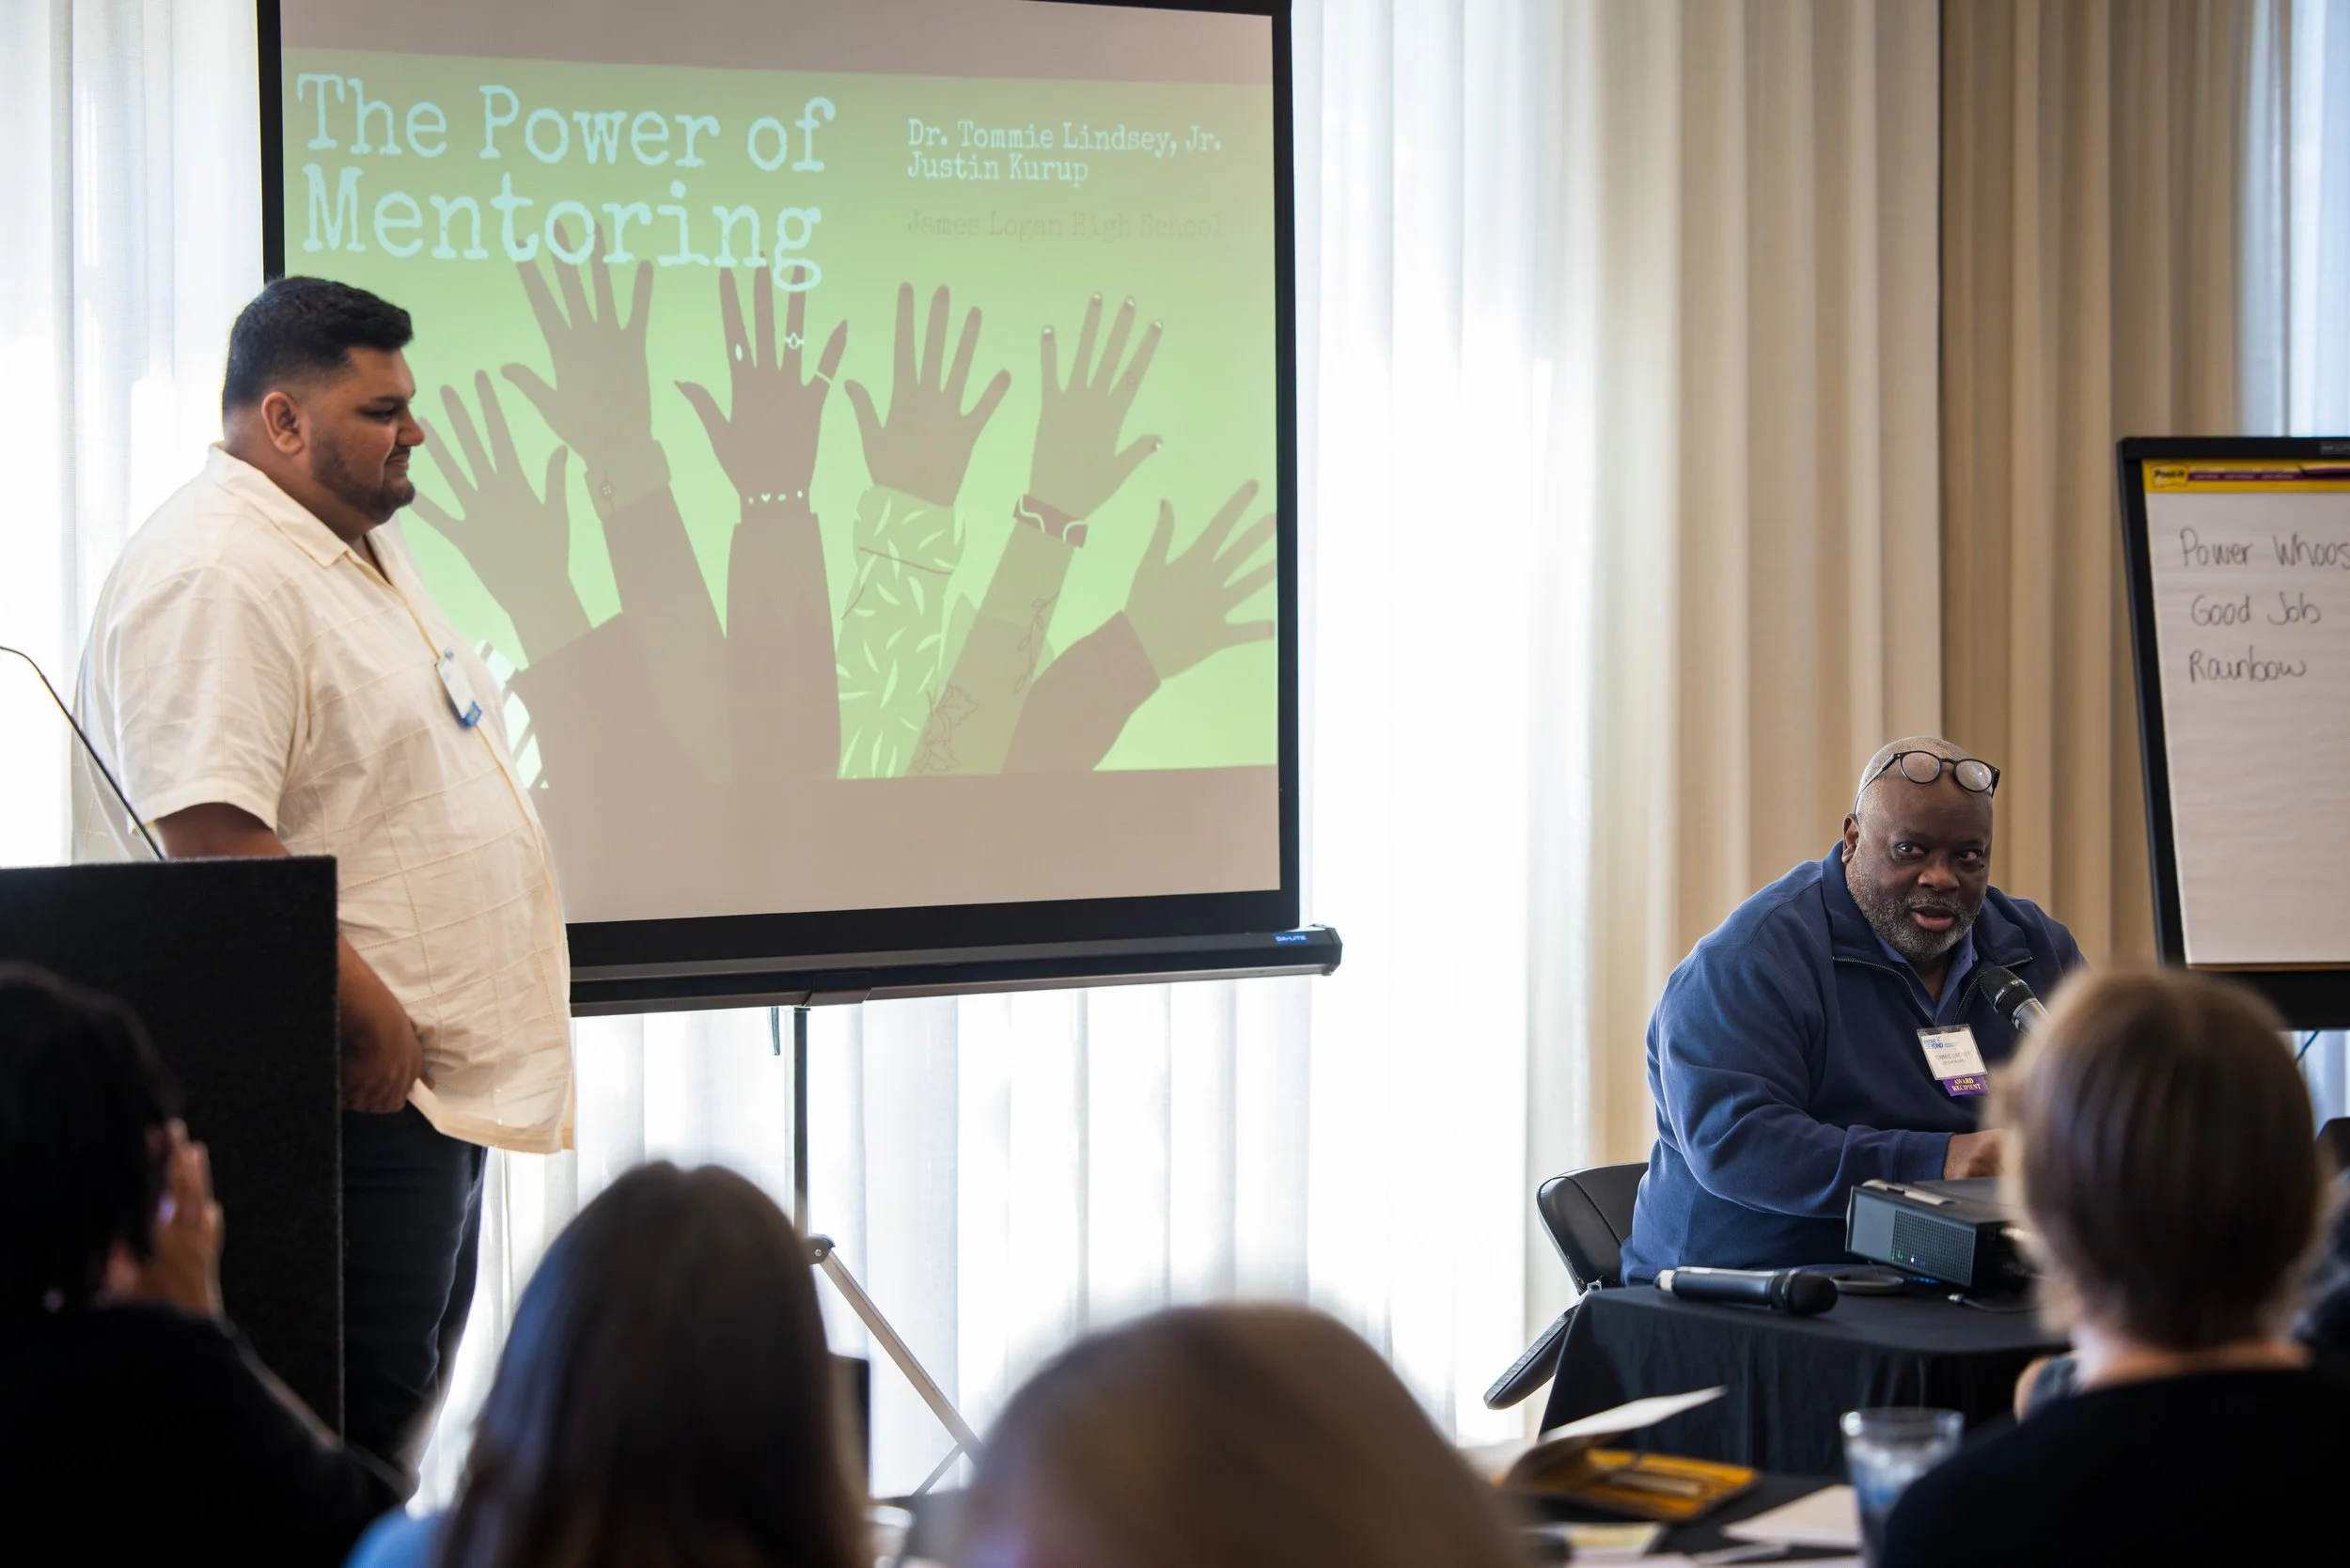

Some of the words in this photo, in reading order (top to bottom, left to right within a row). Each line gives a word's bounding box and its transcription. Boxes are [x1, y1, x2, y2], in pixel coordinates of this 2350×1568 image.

[297, 73, 447, 158] The
[478, 85, 720, 167] Power
[747, 96, 836, 172] of
[907, 118, 948, 148] Dr.
[957, 119, 1054, 150] Tommie
[1062, 121, 1177, 159] Lindsey,
[1185, 124, 1221, 152] Jr.
[907, 150, 999, 181] Justin
[1009, 153, 1089, 187] Kurup
[302, 163, 822, 292] Mentoring
[907, 209, 980, 237] James
[989, 210, 1062, 242] Logan
[1072, 212, 1131, 243] High
[1139, 212, 1226, 239] School
[2180, 526, 2253, 567] Power
[2190, 594, 2251, 627] Good
[2266, 590, 2321, 626] Job
[2188, 644, 2307, 683] Rainbow
